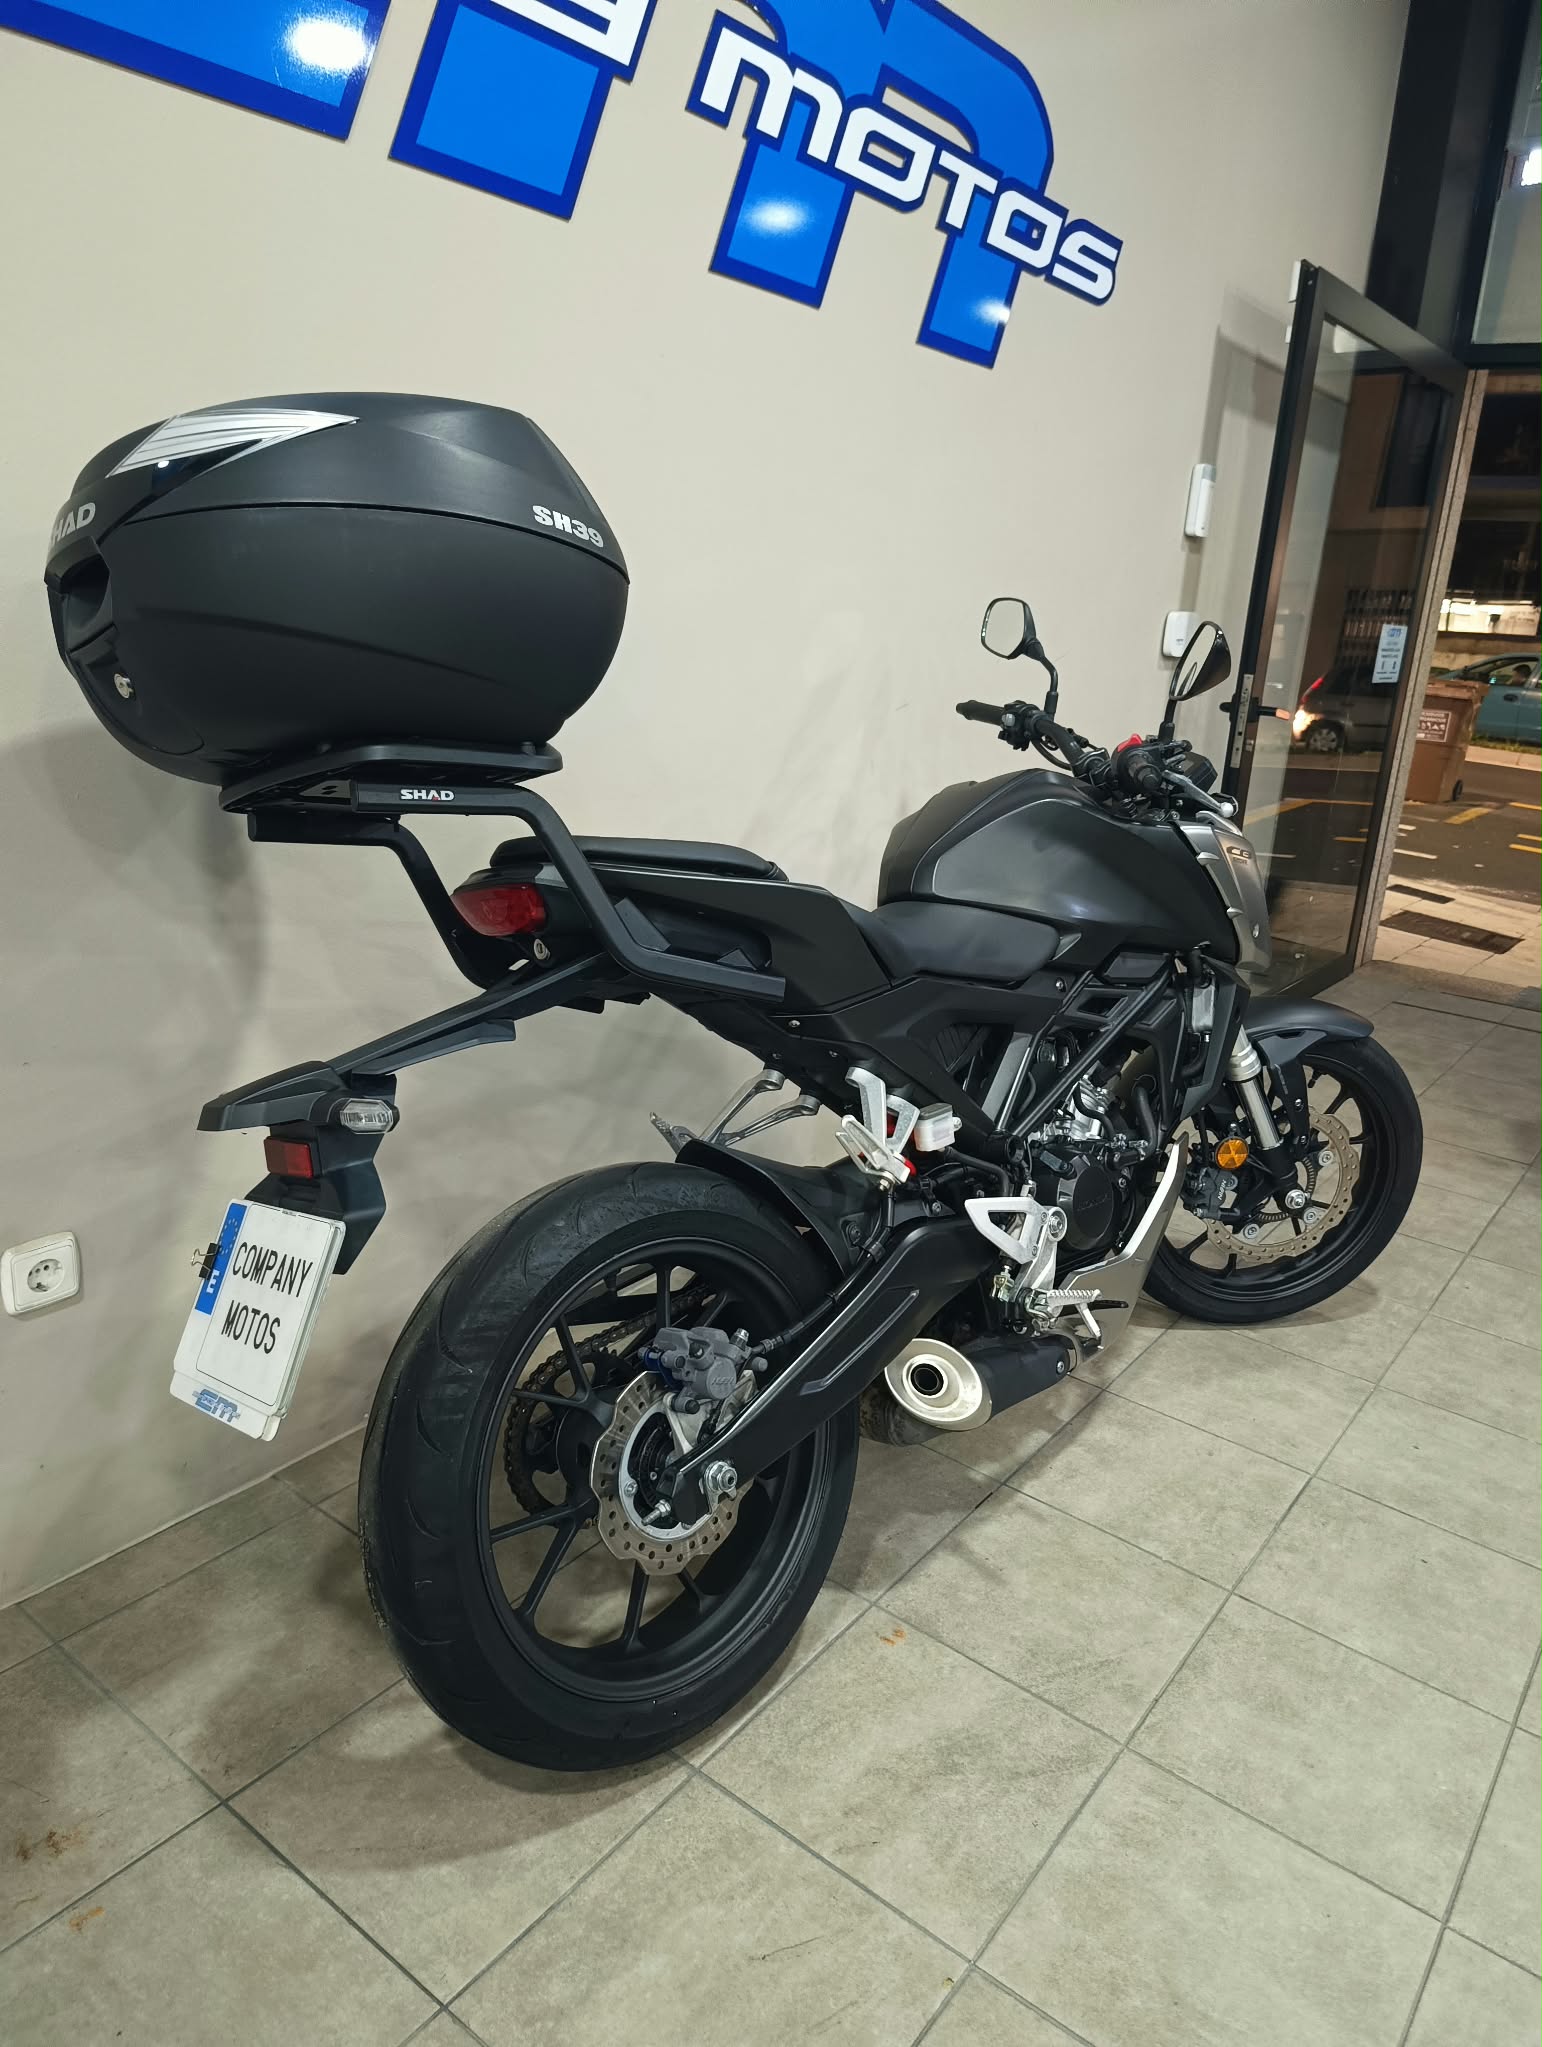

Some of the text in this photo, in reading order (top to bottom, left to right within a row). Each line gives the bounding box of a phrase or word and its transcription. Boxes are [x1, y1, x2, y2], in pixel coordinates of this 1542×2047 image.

[699, 26, 1119, 300] MOTOS
[51, 502, 96, 547] HAD
[532, 505, 604, 548] SH39
[400, 789, 455, 801] SHAD
[206, 1269, 220, 1294] E
[232, 1241, 314, 1298] COMPANY
[221, 1299, 281, 1354] MOTOS
